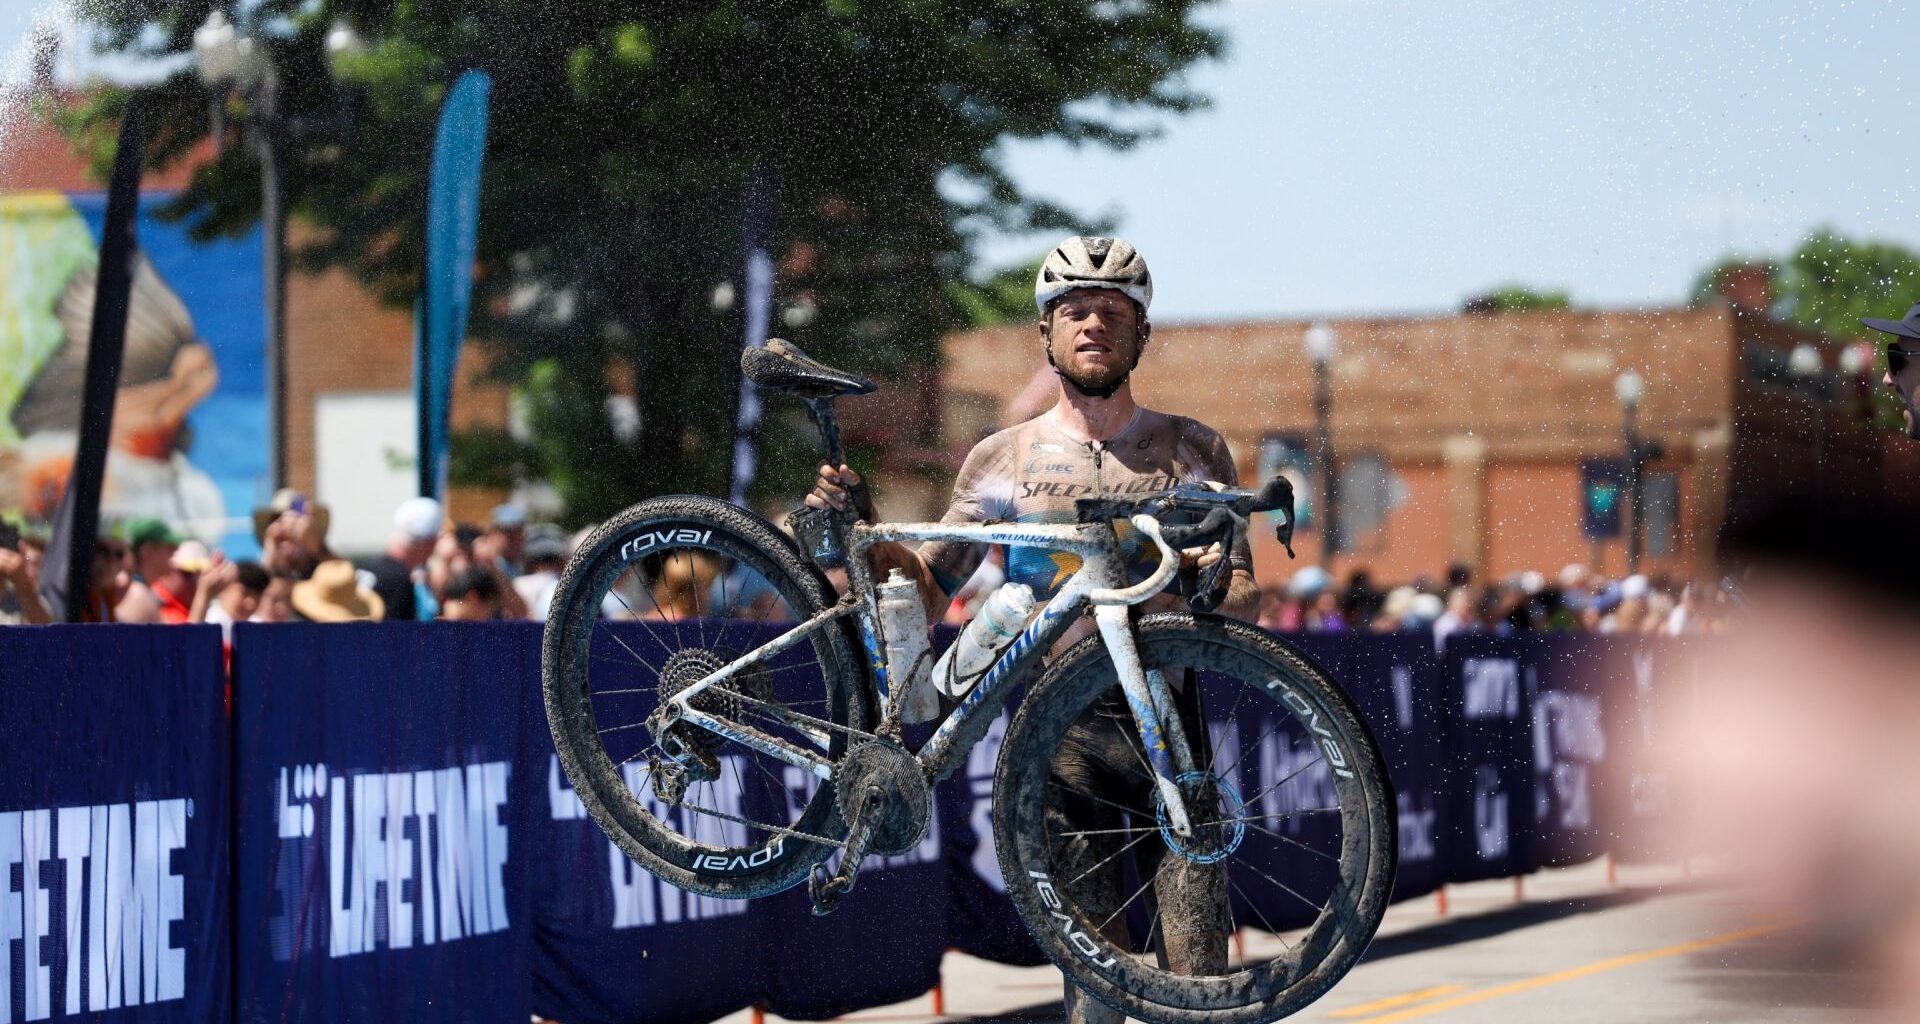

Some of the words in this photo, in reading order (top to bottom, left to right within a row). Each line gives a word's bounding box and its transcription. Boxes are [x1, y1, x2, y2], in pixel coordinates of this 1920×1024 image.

[1045, 463, 1074, 472] UEC
[1021, 475, 1180, 499] SPECILIZED
[621, 529, 712, 560] roval
[1266, 679, 1354, 779] roval
[692, 839, 784, 870] roval
[1028, 870, 1117, 968] roval
